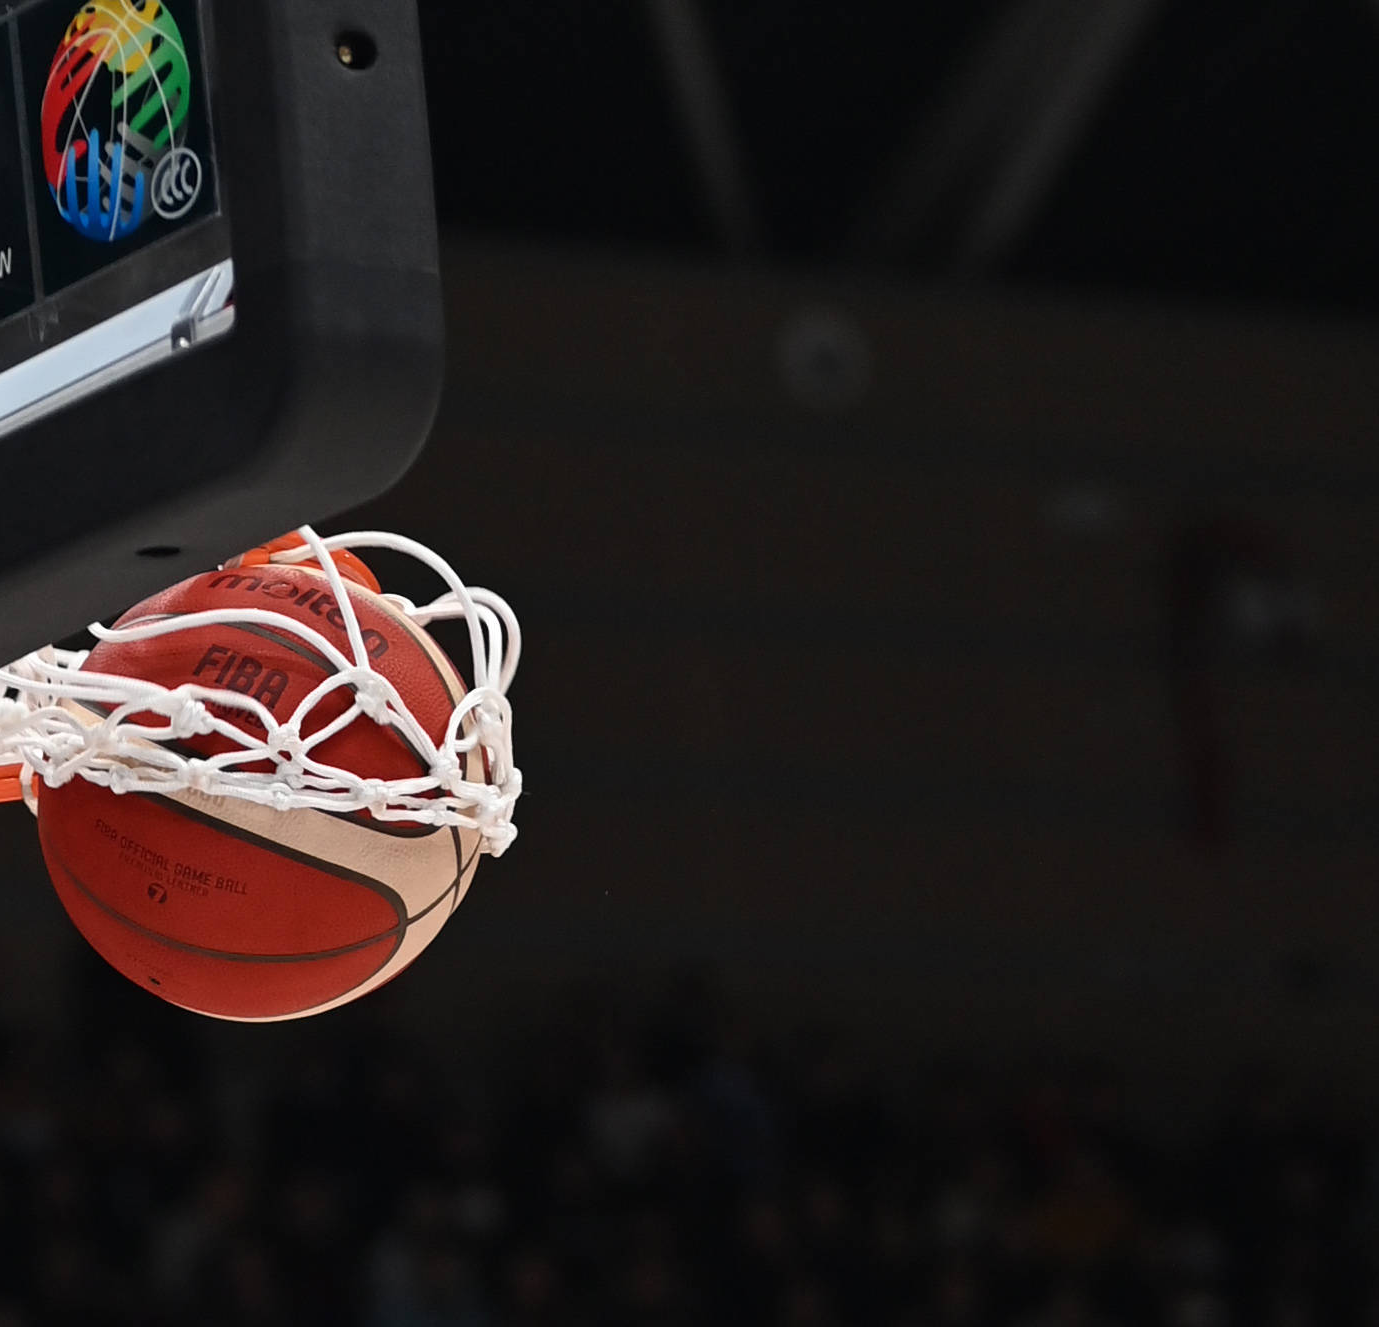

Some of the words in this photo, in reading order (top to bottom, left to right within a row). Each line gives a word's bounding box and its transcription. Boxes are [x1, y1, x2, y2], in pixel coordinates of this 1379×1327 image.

[208, 573, 389, 660] molten
[192, 643, 290, 711] FIBA
[120, 835, 171, 871] OFFICIAL
[173, 862, 214, 887] GAME
[215, 876, 248, 895] BALL
[147, 882, 168, 904] 7
